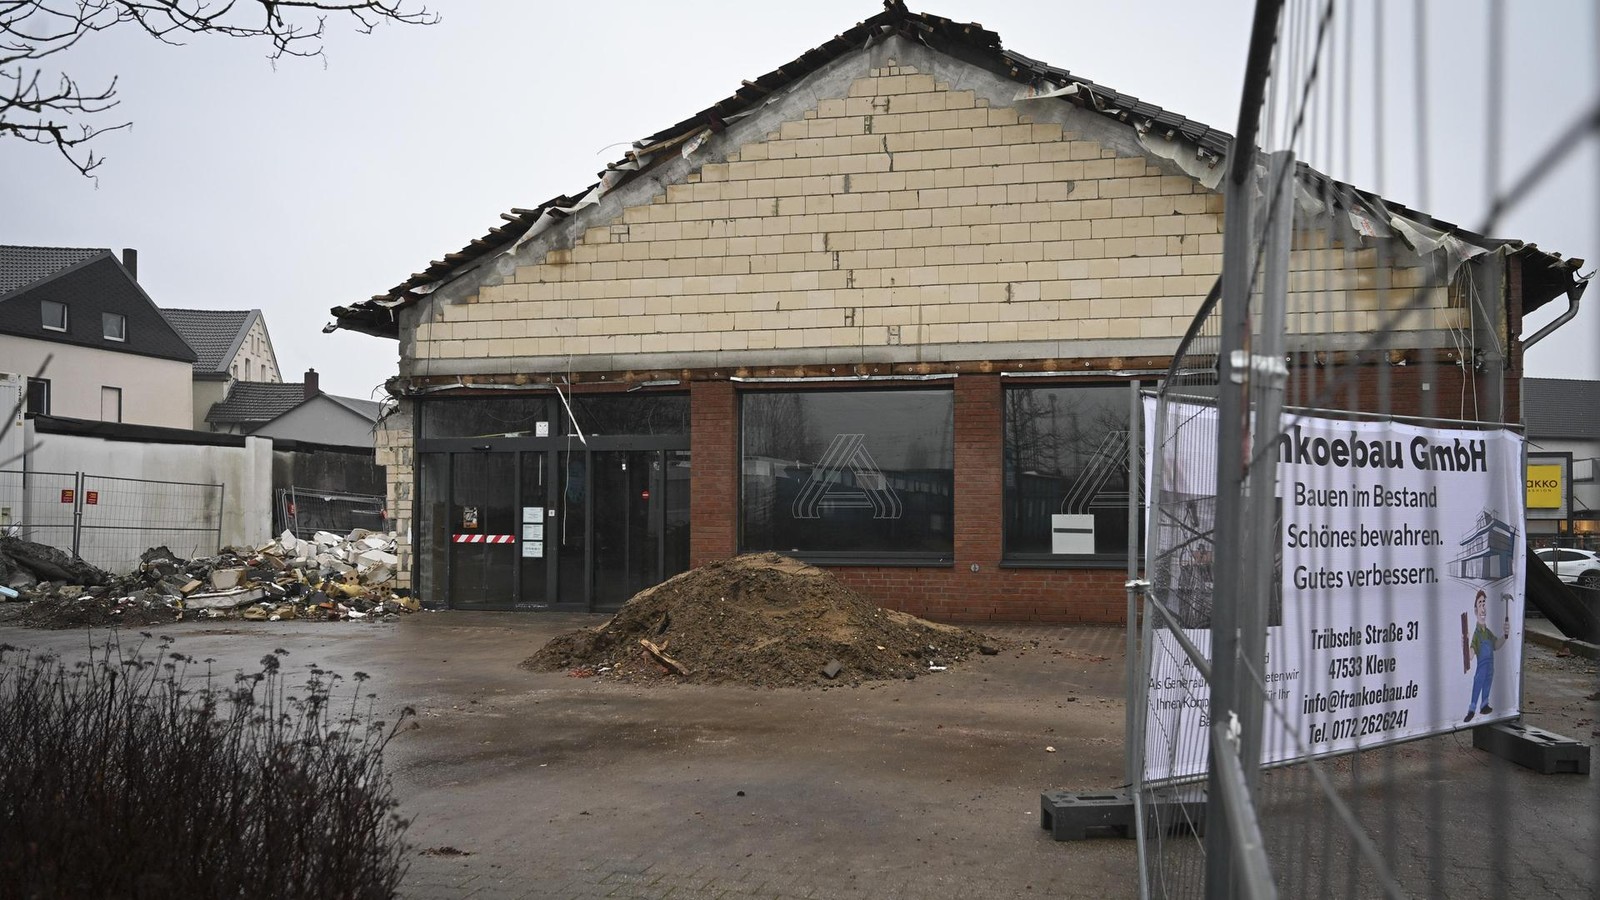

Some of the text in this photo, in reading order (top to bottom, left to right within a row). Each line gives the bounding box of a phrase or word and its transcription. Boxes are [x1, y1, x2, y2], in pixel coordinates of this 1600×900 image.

[1278, 425, 1488, 472] nkoebau GmbH
[1294, 481, 1438, 508] Bauen im Bestand
[1287, 523, 1444, 548] Schönes bewahren.
[1293, 563, 1439, 590] Gutes verbessern.
[1311, 621, 1419, 650] Trübsche Straße 31
[1328, 654, 1396, 679] 47533 Kleve
[1303, 680, 1419, 714] info@frankoebau.de
[1309, 709, 1409, 744] Tel. 0172 2626241
